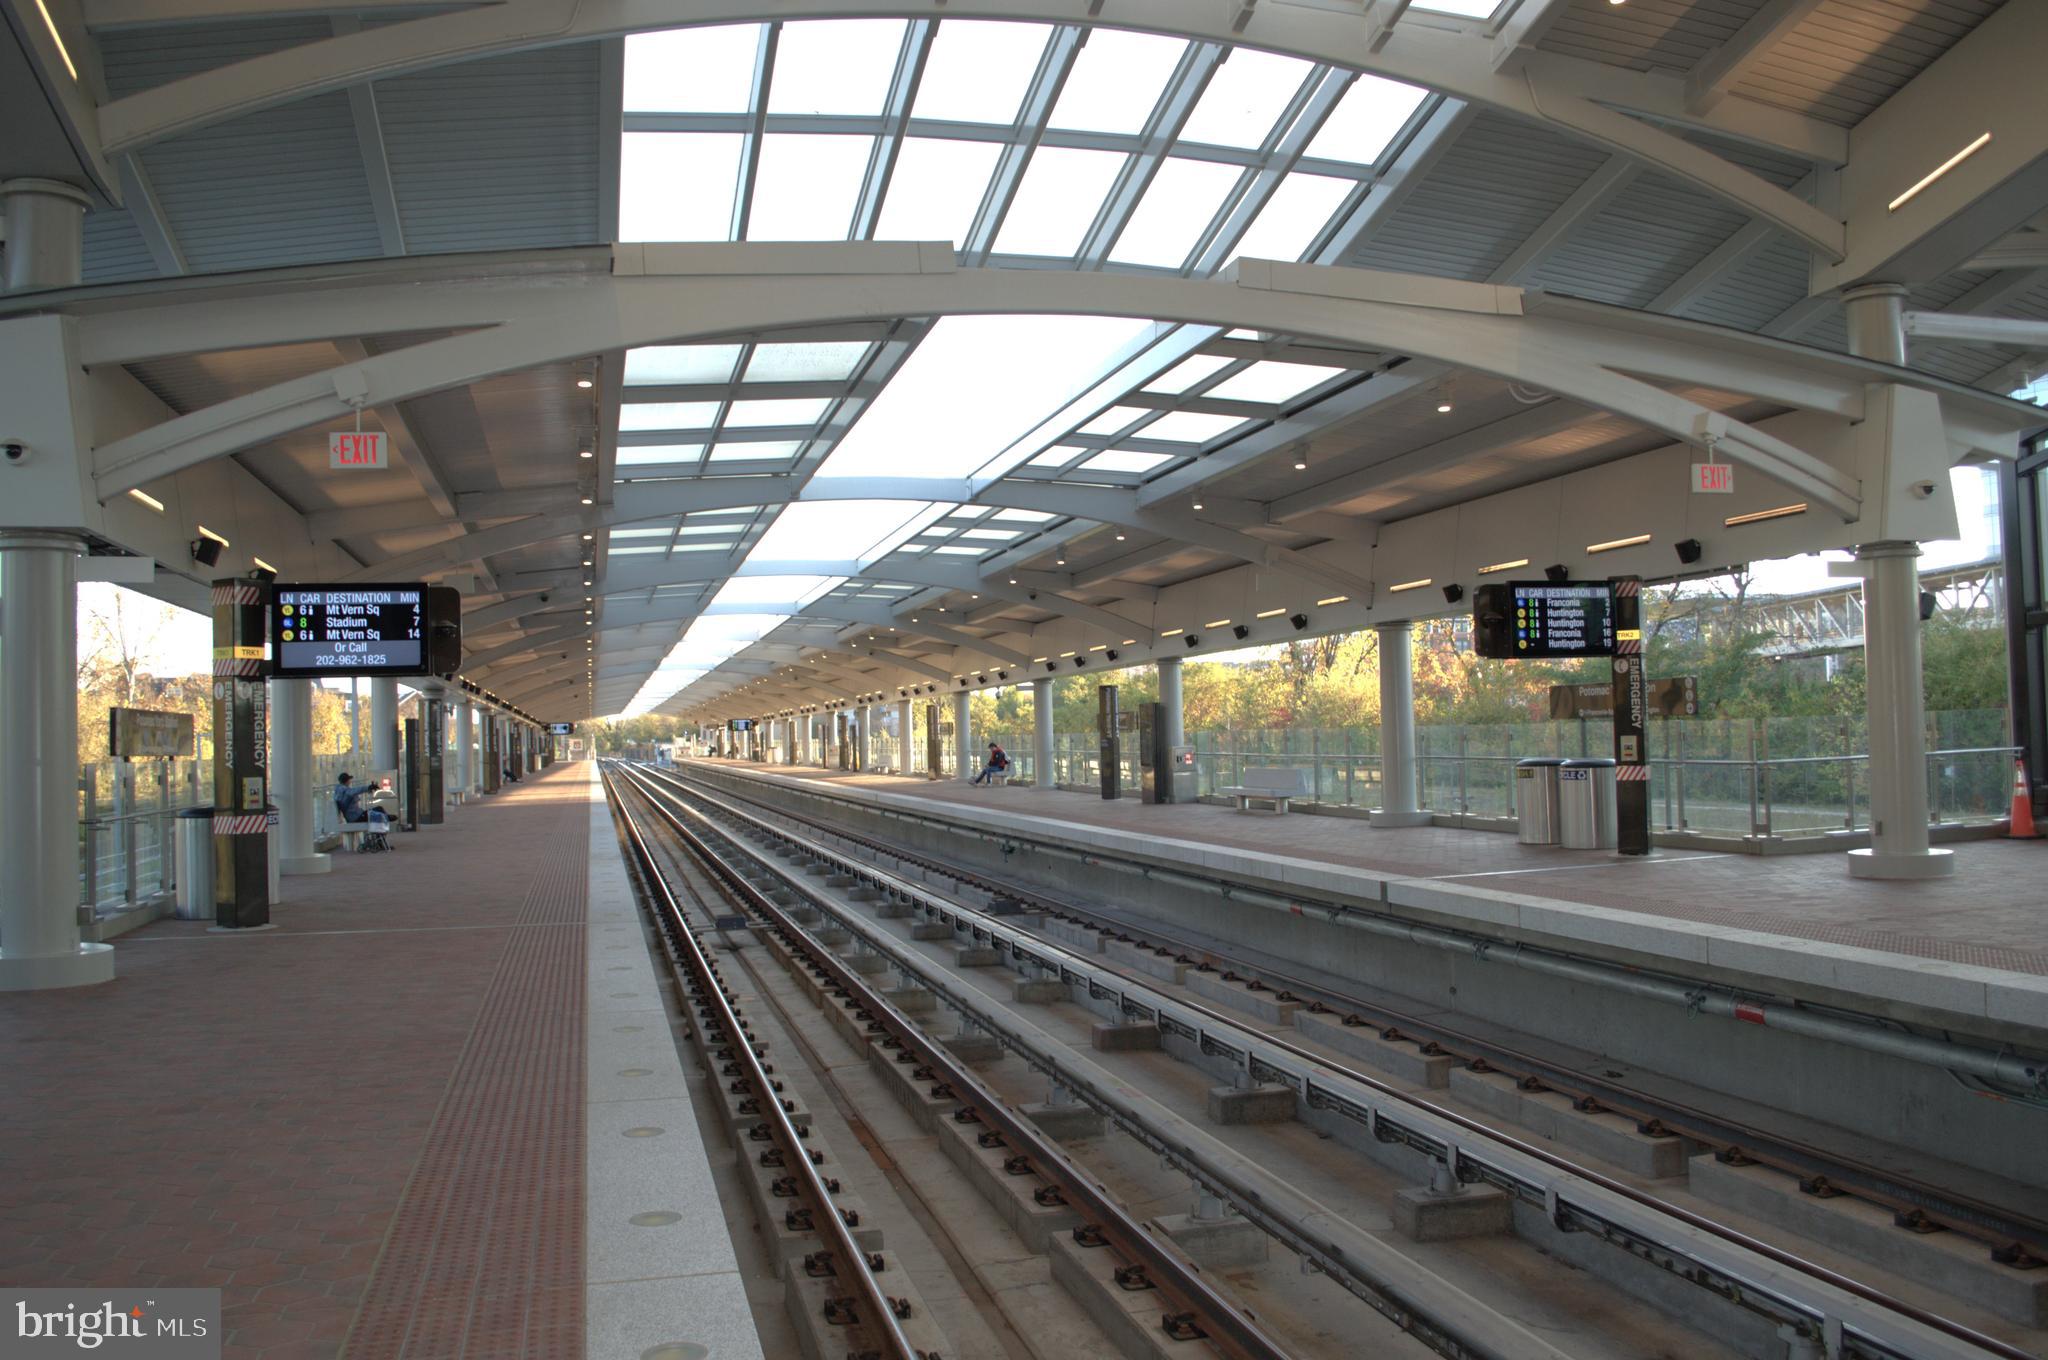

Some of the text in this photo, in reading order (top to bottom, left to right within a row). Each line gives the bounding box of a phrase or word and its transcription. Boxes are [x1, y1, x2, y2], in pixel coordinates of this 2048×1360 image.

[340, 434, 379, 465] EXIT
[1701, 465, 1728, 490] EXIT
[280, 592, 420, 603] LN CAR DESTINATION MIN
[1515, 588, 1525, 598] LN
[1529, 588, 1543, 598] CAR
[1546, 588, 1591, 598] DESTINATION
[1547, 598, 1580, 607] Franconia
[300, 604, 307, 615] 6
[326, 604, 340, 615] Mt
[341, 604, 364, 615] Vern
[366, 604, 380, 616] Sq
[413, 604, 420, 614] 4
[1547, 608, 1584, 618] Huntington
[300, 617, 307, 628] 8
[326, 617, 367, 628] Stadium
[413, 616, 420, 626] 7
[1547, 619, 1584, 629] Huntington
[300, 630, 307, 640] 6
[326, 629, 340, 640] Mt
[341, 629, 364, 640] Vern
[366, 629, 380, 641] Sq
[408, 629, 420, 639] 14
[1548, 629, 1582, 638] Franconia
[334, 642, 367, 652] Or Call
[1548, 639, 1586, 650] Huntington
[242, 648, 259, 656] TRK1
[315, 654, 387, 666] 202-962-1825
[1578, 686, 1610, 697] Potomac
[1630, 658, 1641, 729] EMERGENCY
[225, 681, 233, 769] EMERGENCY
[253, 681, 265, 768] EMERGENCY
